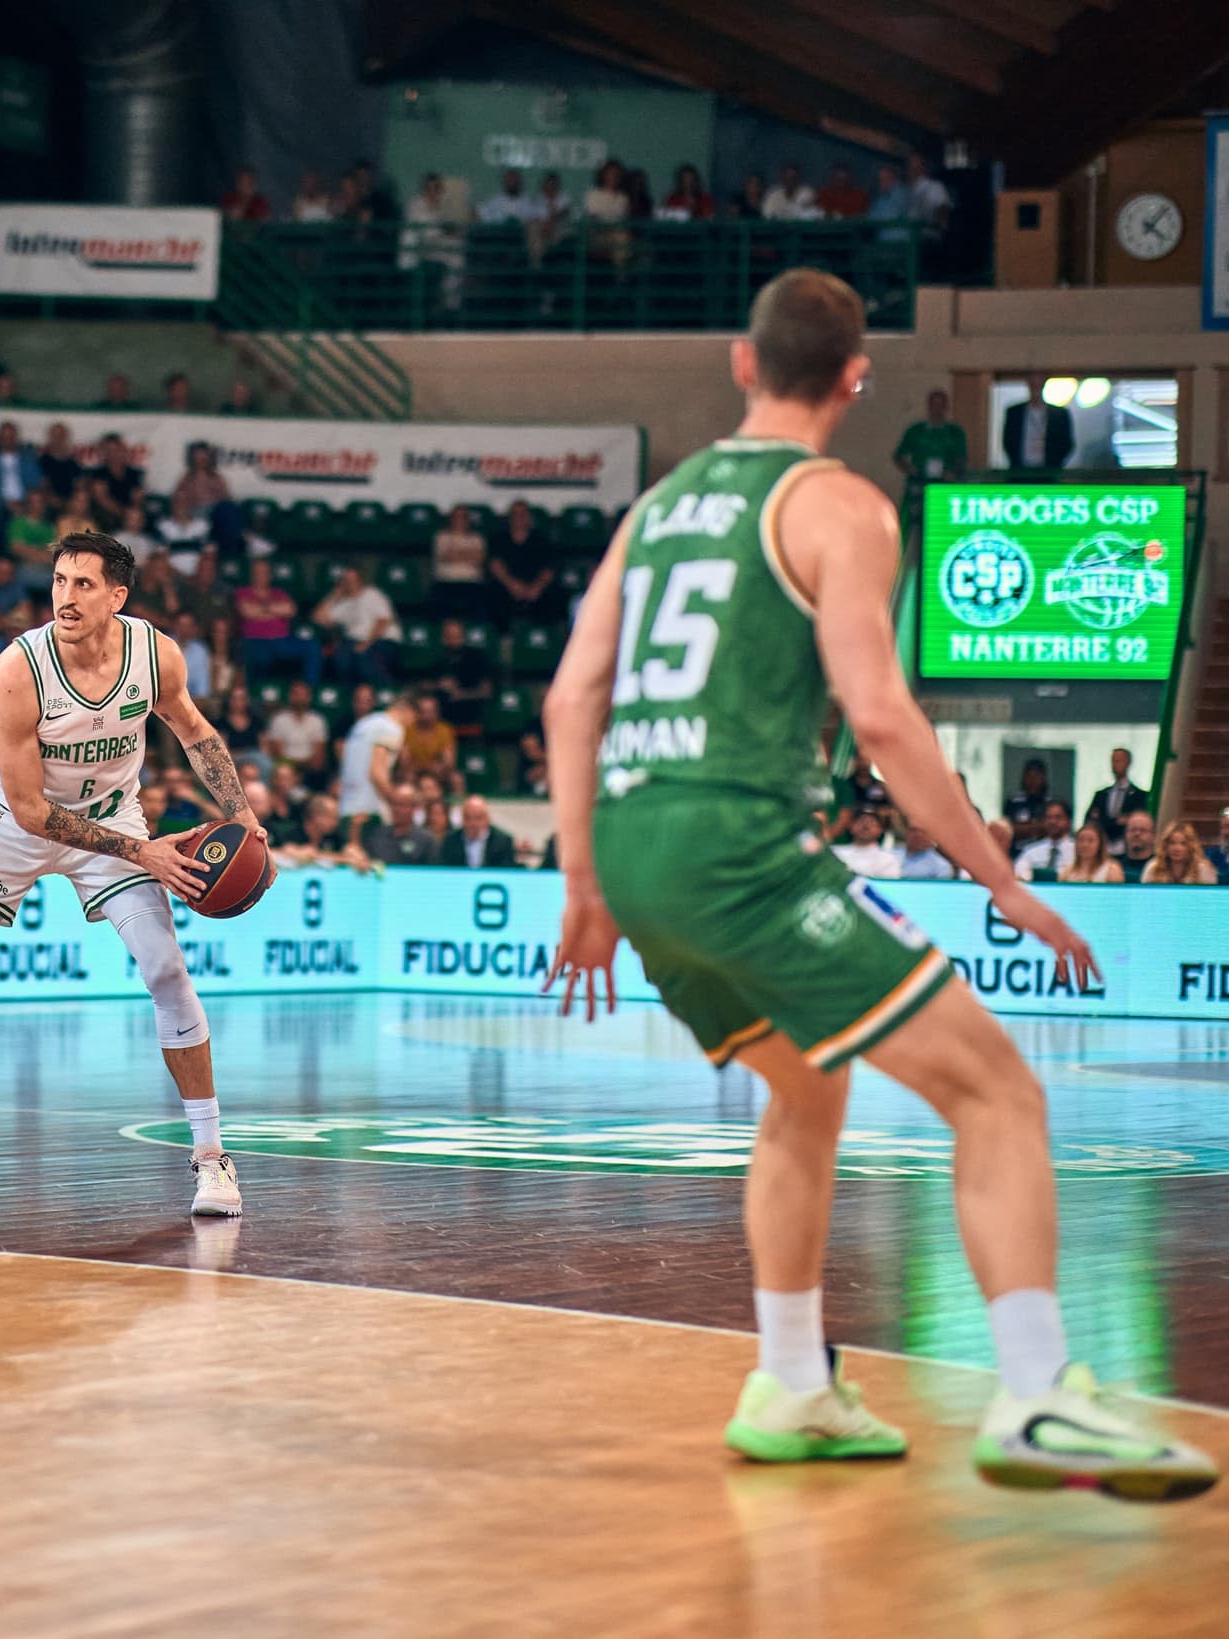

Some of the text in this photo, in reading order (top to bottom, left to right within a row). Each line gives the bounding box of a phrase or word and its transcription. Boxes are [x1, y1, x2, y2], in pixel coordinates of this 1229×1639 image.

[951, 496, 1159, 525] LIMOGES CSP
[952, 552, 1021, 600] CSP
[612, 559, 738, 706] 15
[950, 632, 1149, 663] NANTERRE 92
[264, 940, 360, 975] FIDUCIAL
